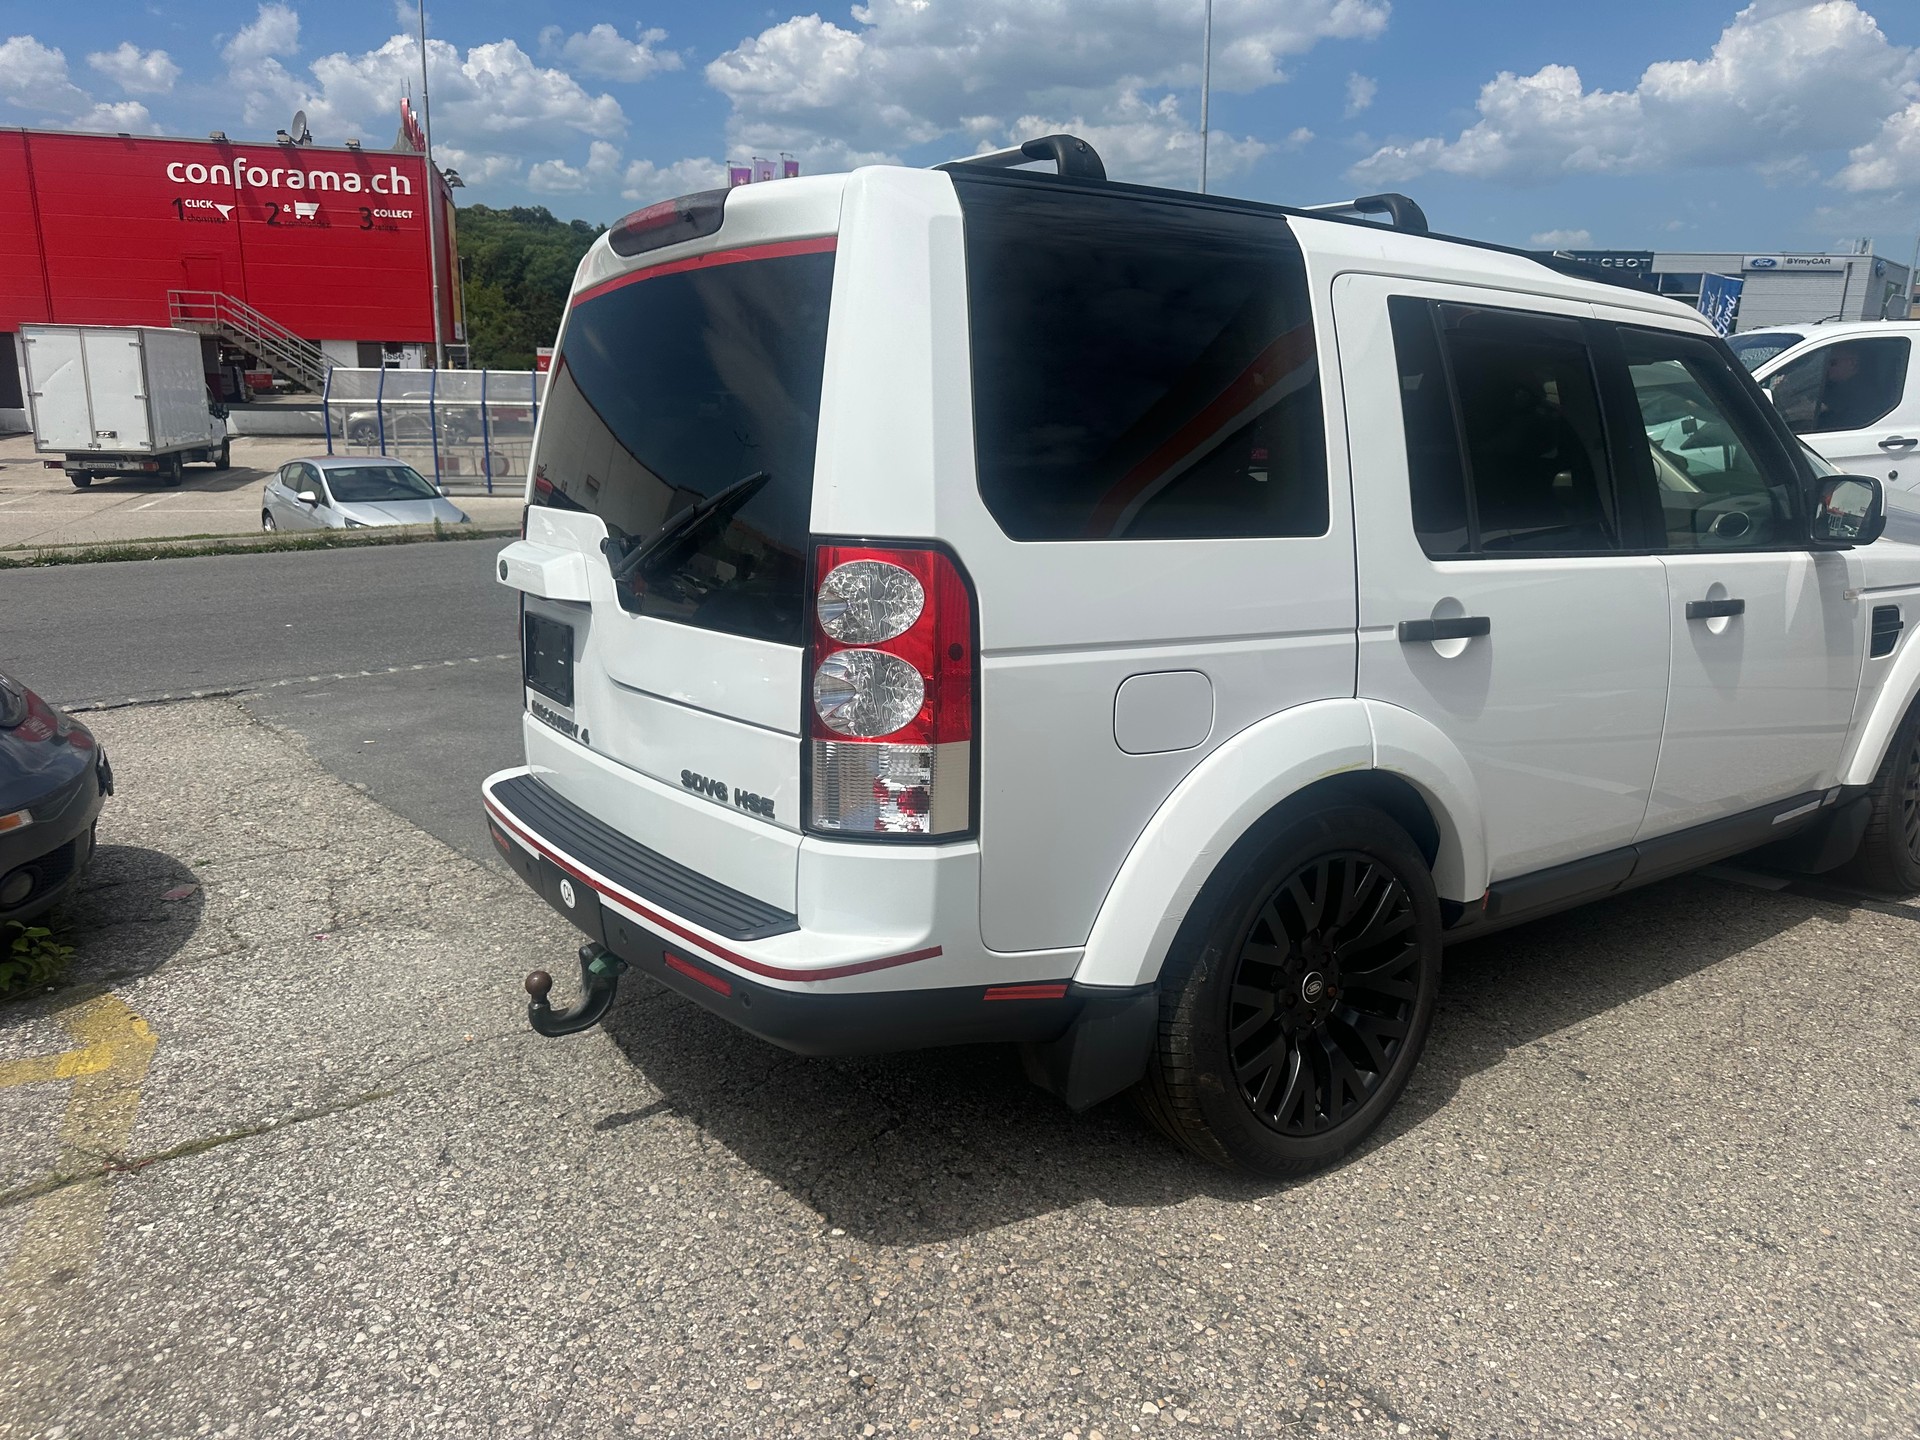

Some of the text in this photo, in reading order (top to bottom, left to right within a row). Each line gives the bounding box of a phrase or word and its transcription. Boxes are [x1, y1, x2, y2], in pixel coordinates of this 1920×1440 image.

[166, 157, 411, 195] conforama.ch
[172, 197, 214, 221] 1 CLICK
[265, 202, 292, 227] 2 &
[359, 206, 413, 231] 3 COLLECT
[1786, 258, 1831, 266] BYmyCAR
[1716, 294, 1737, 336] Ford
[581, 728, 590, 745] 4
[681, 769, 775, 819] SDV6 HSE
